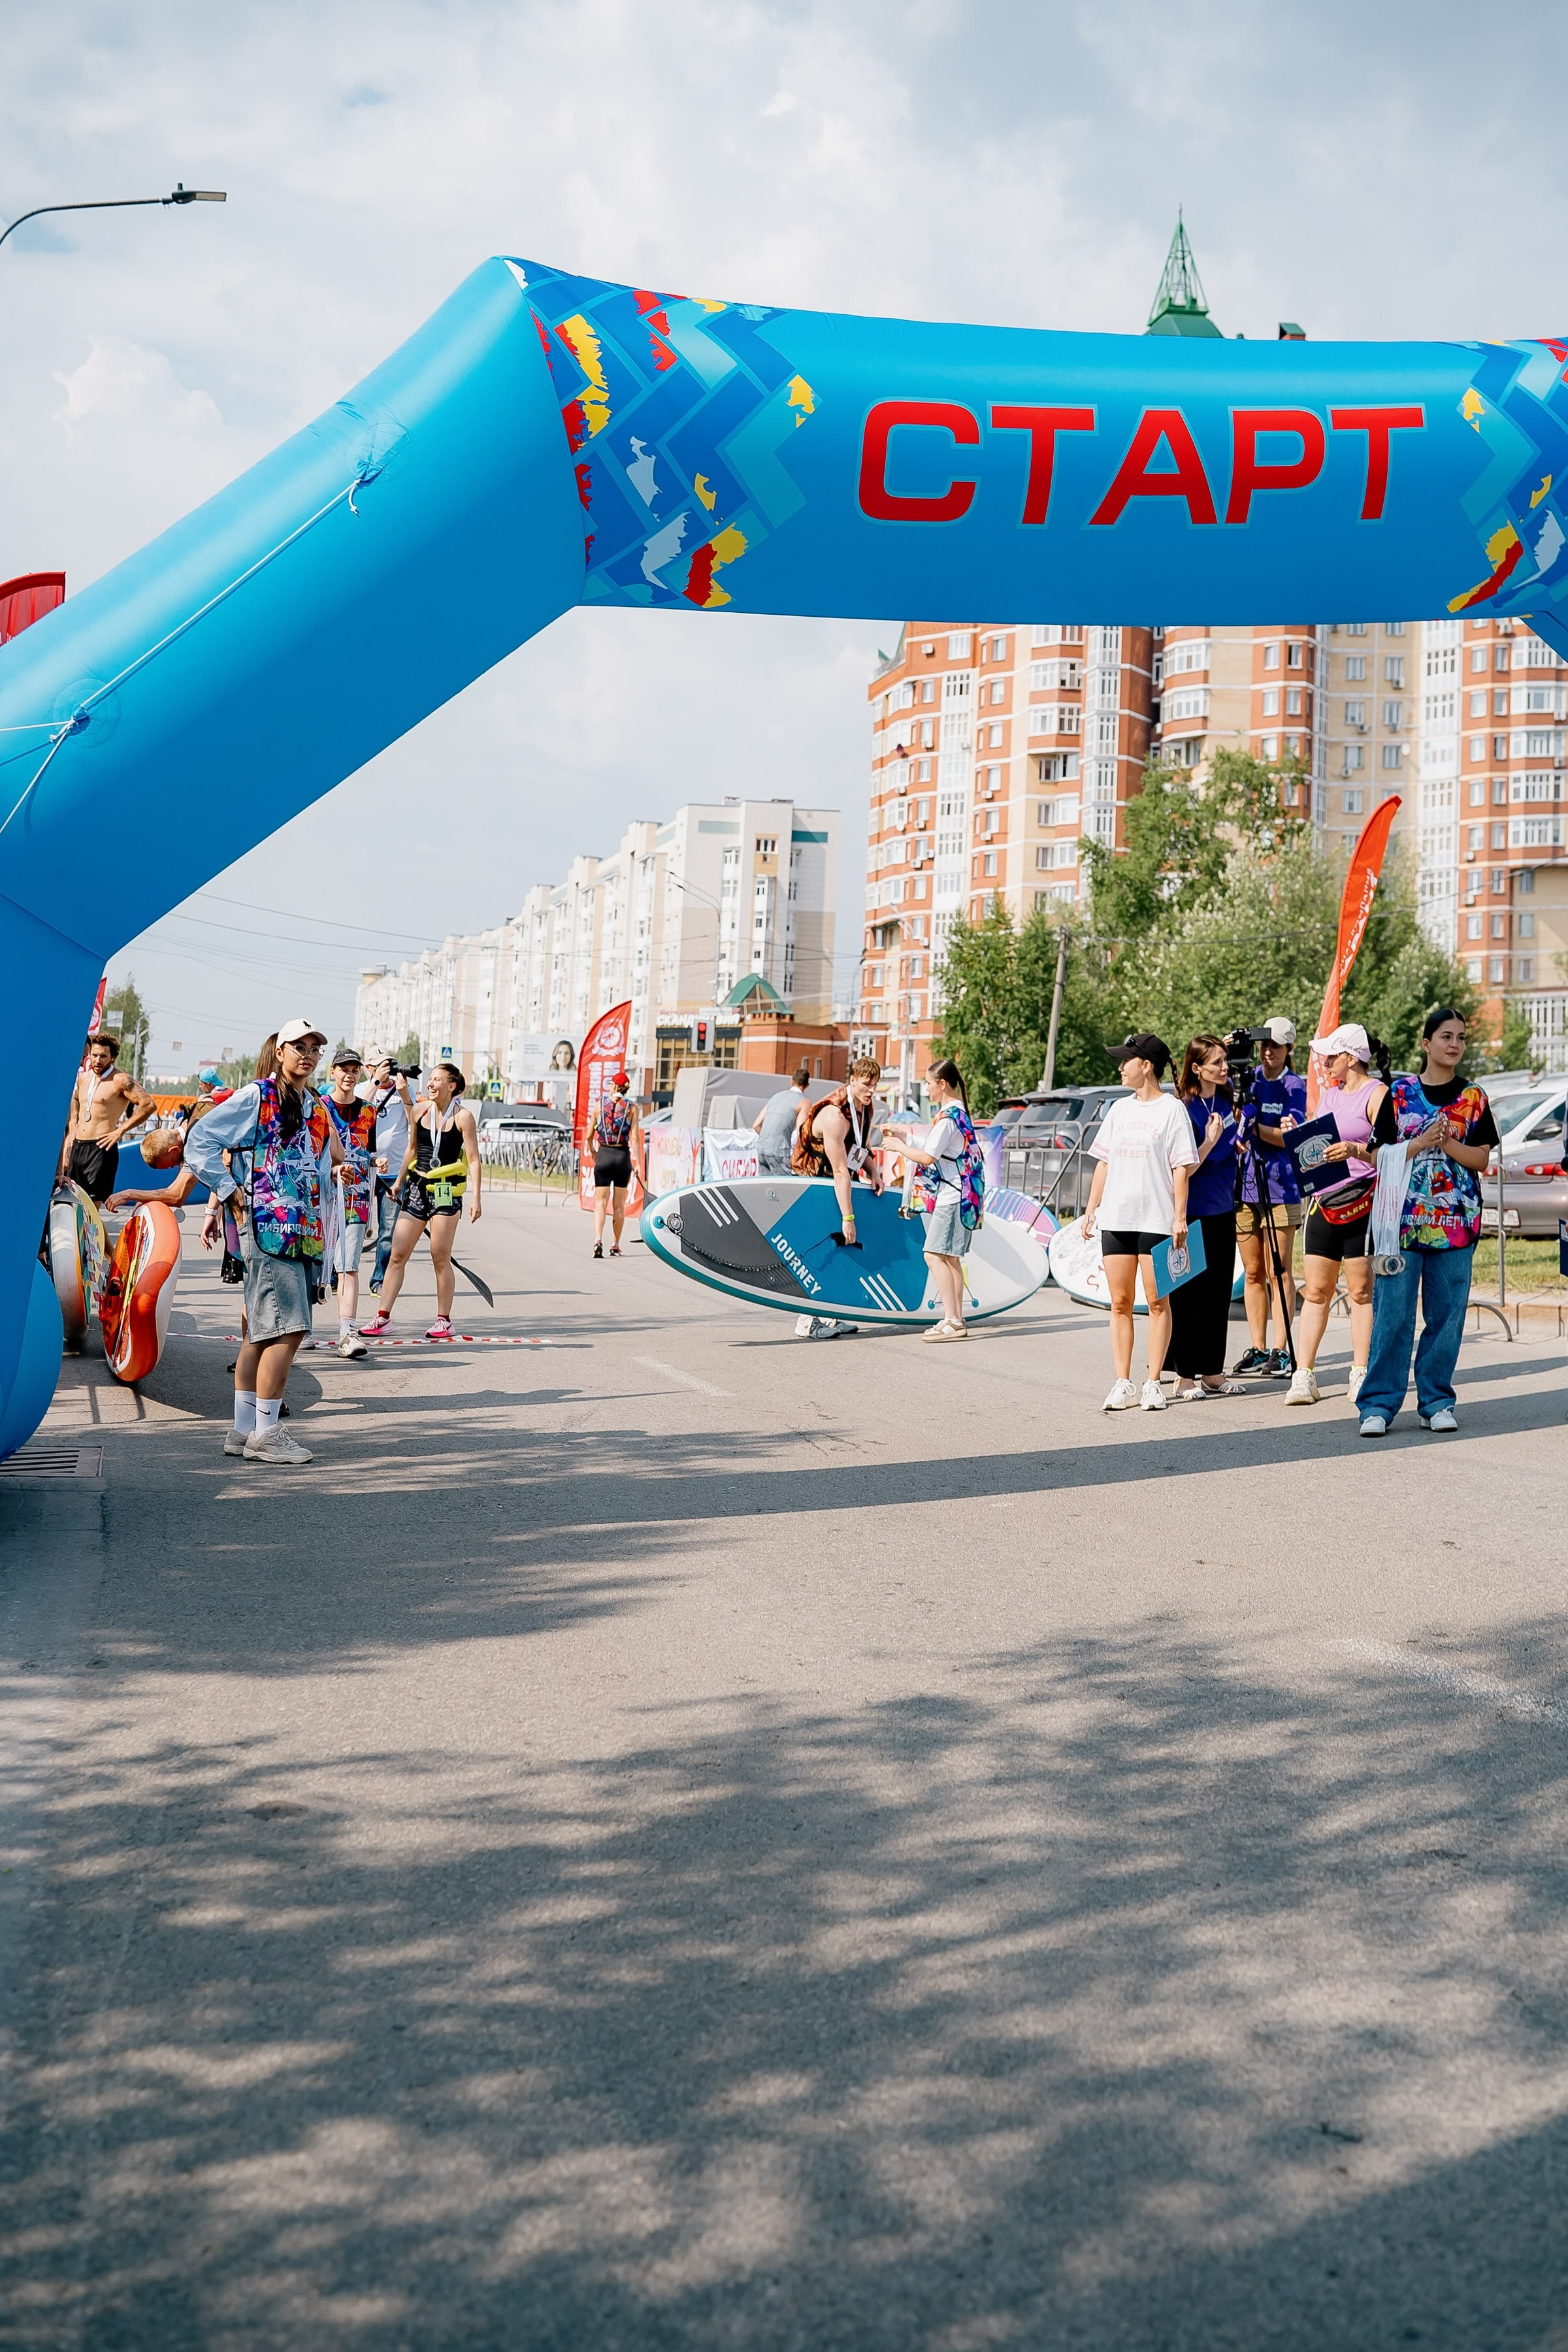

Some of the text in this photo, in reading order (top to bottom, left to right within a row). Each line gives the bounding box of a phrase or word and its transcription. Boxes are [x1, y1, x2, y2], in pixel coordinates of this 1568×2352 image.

[858, 399, 1426, 527] СТАРТ
[657, 1013, 740, 1028] СКАНДВИЯ
[1116, 1149, 1150, 1158] MY BEST
[438, 1186, 450, 1197] 14
[1346, 1201, 1369, 1218] LEKI
[771, 1233, 822, 1295] JOURNEY
